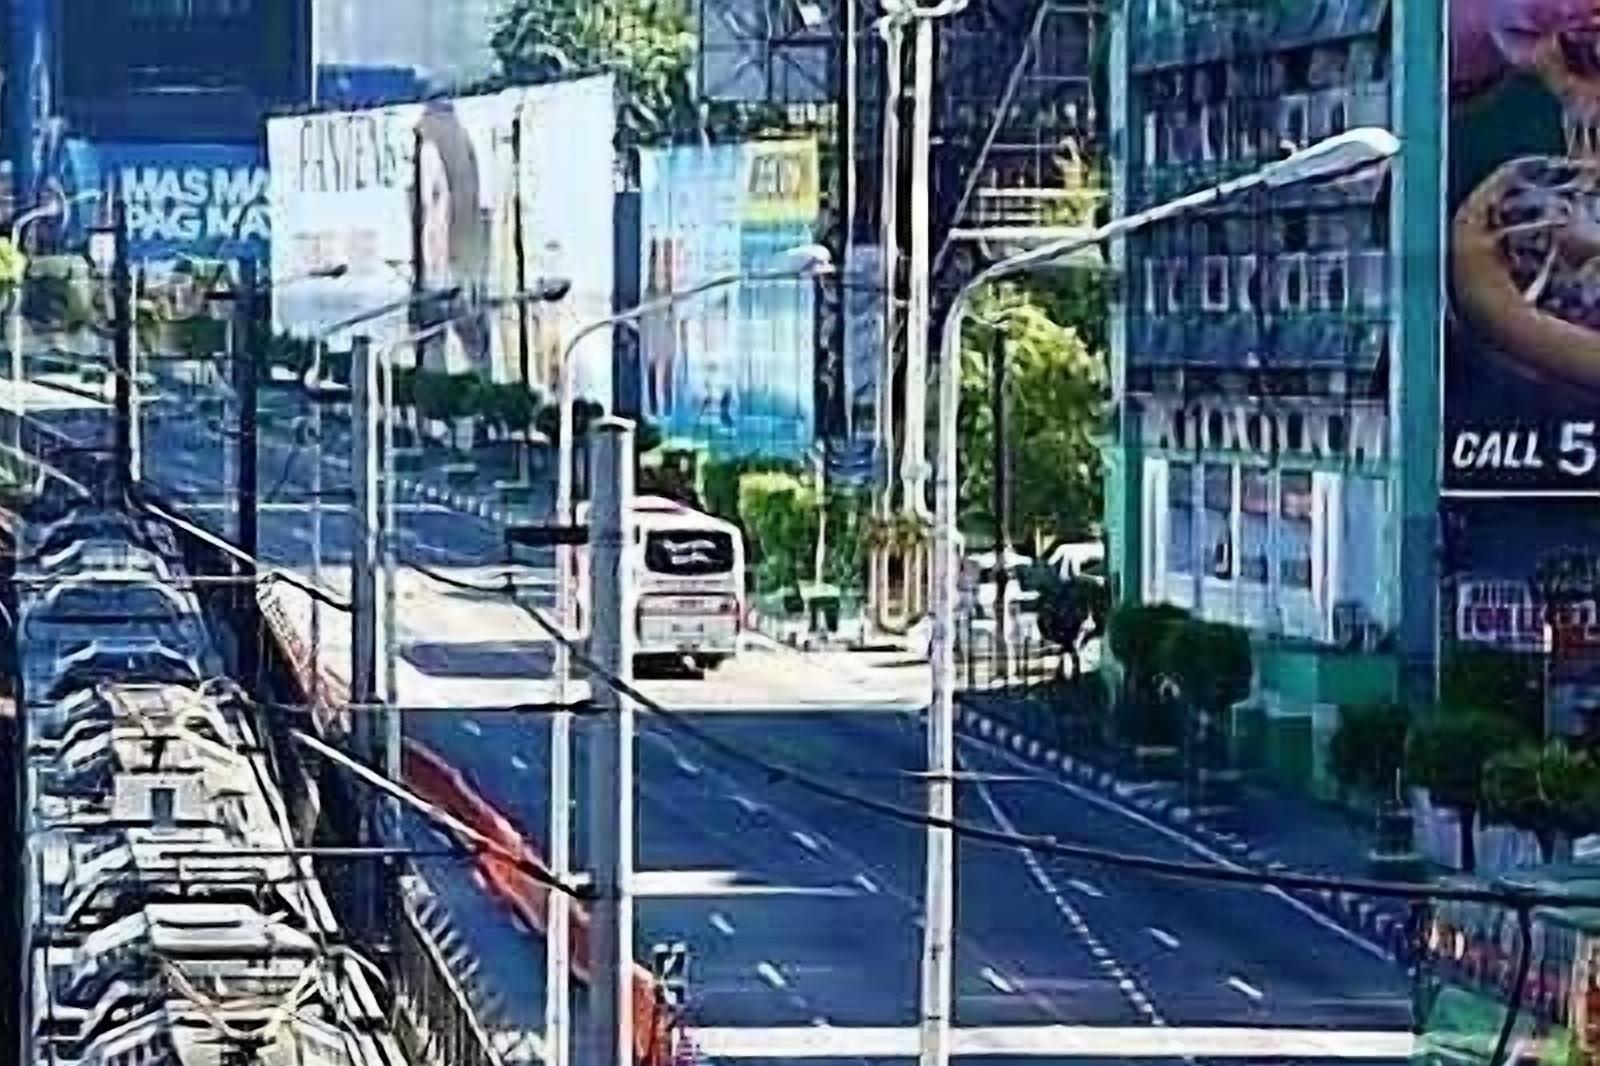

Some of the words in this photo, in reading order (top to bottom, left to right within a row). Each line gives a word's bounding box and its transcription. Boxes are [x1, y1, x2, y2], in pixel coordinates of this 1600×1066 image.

[121, 167, 208, 206] MAS
[125, 202, 201, 241] PAG
[1452, 430, 1544, 468] CALL
[1558, 421, 1596, 476] 5
